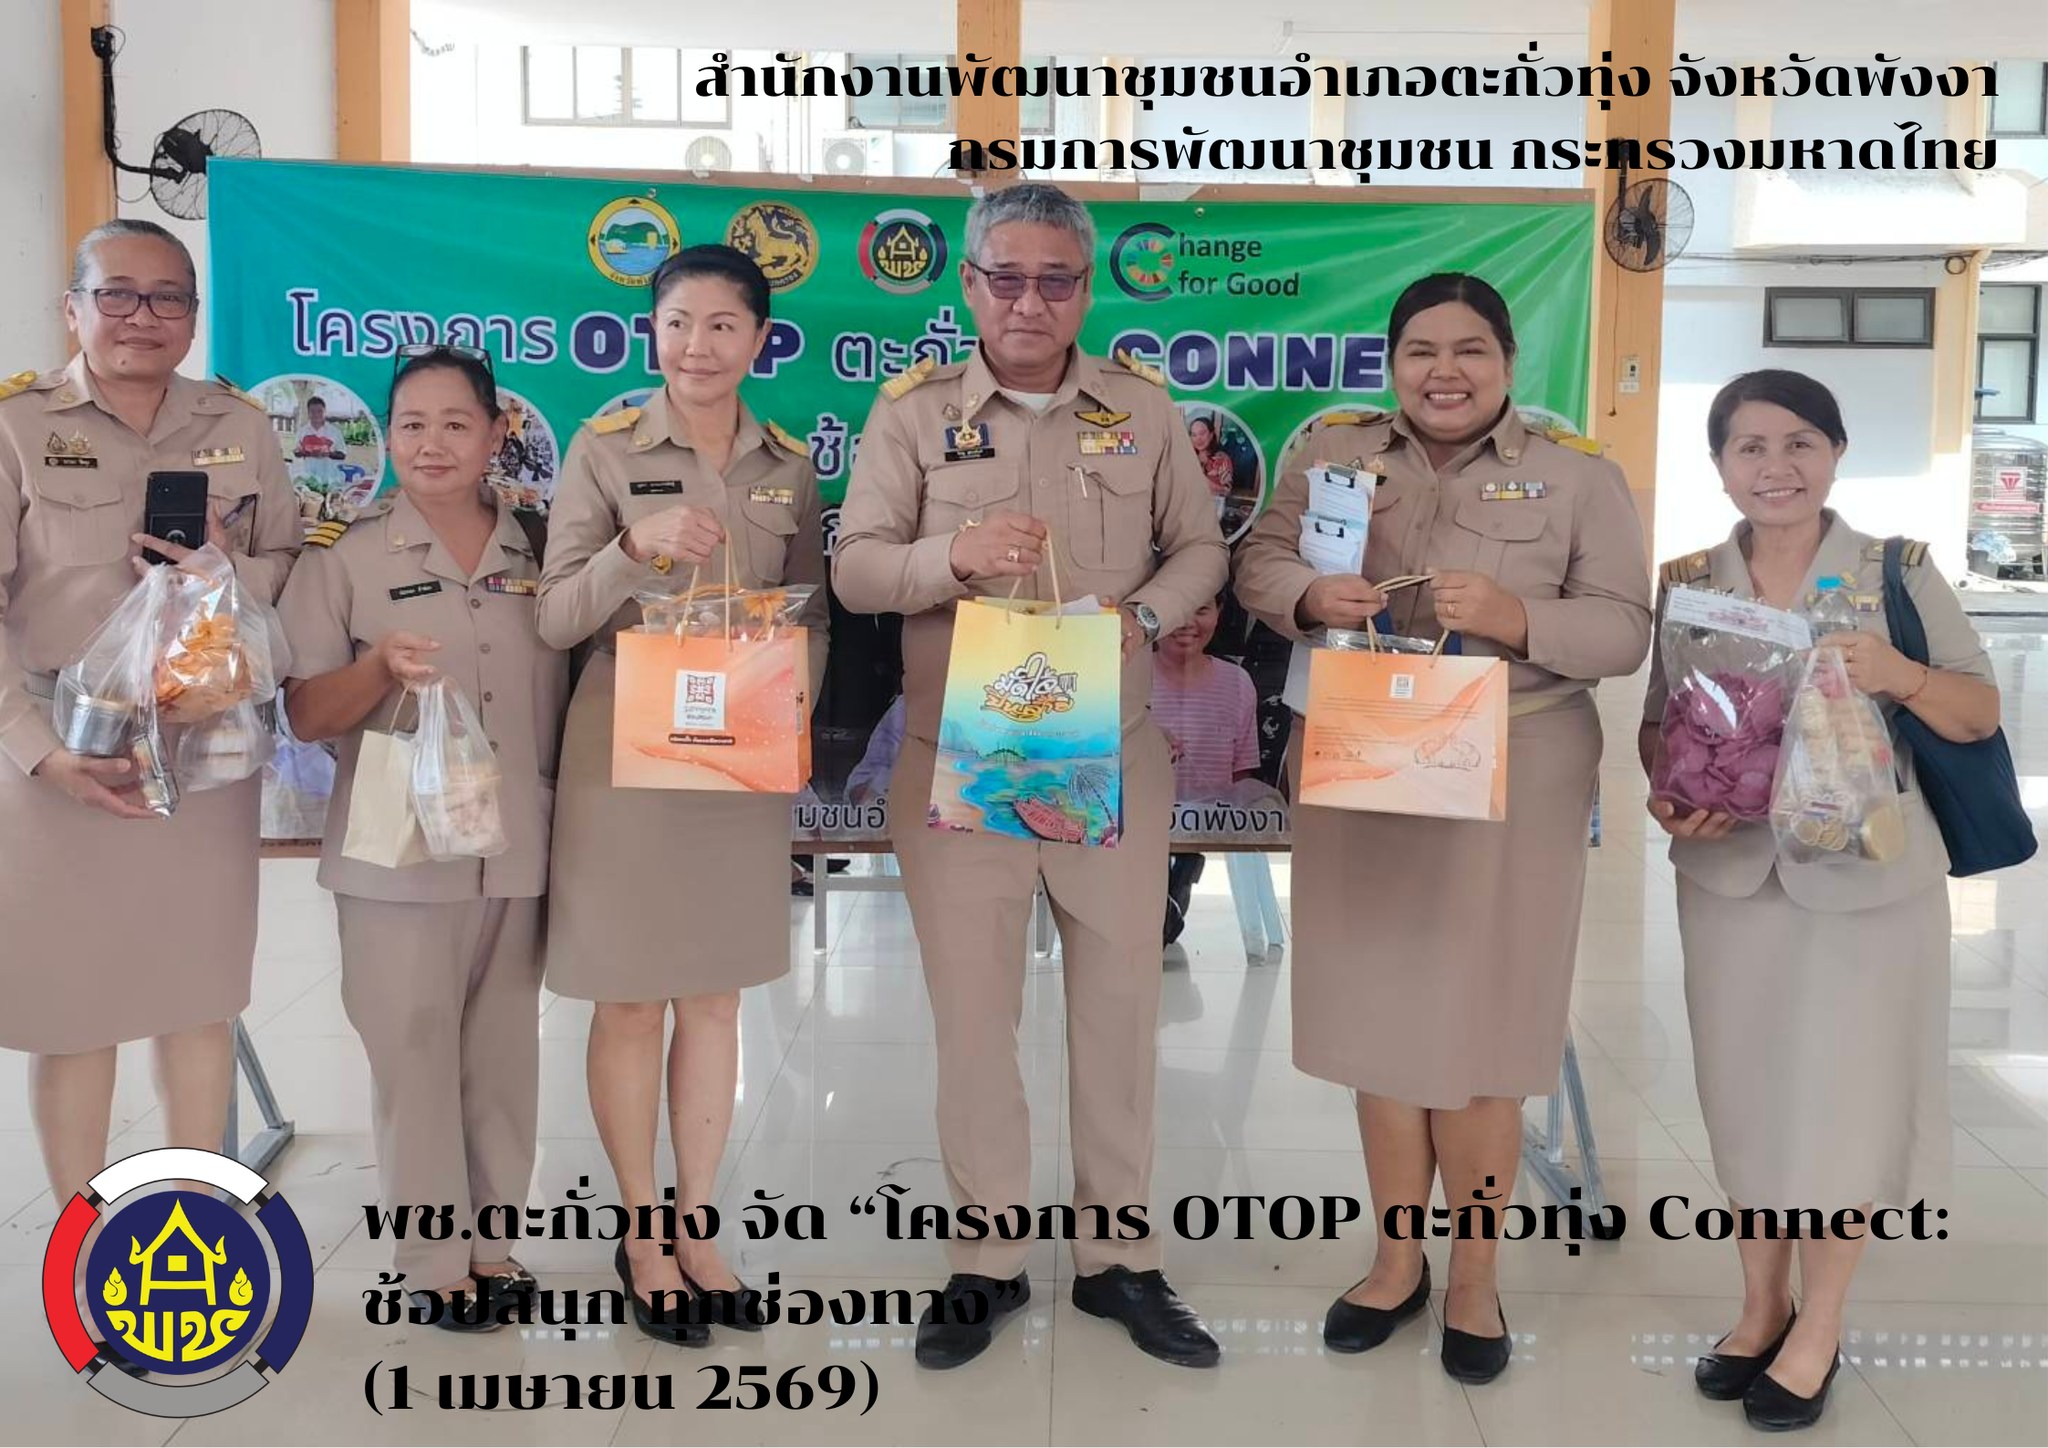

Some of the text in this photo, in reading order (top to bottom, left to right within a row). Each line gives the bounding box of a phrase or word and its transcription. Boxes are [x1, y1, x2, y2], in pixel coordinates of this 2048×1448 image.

[1178, 270, 1299, 296] for Good
[289, 291, 555, 361] โครงการ
